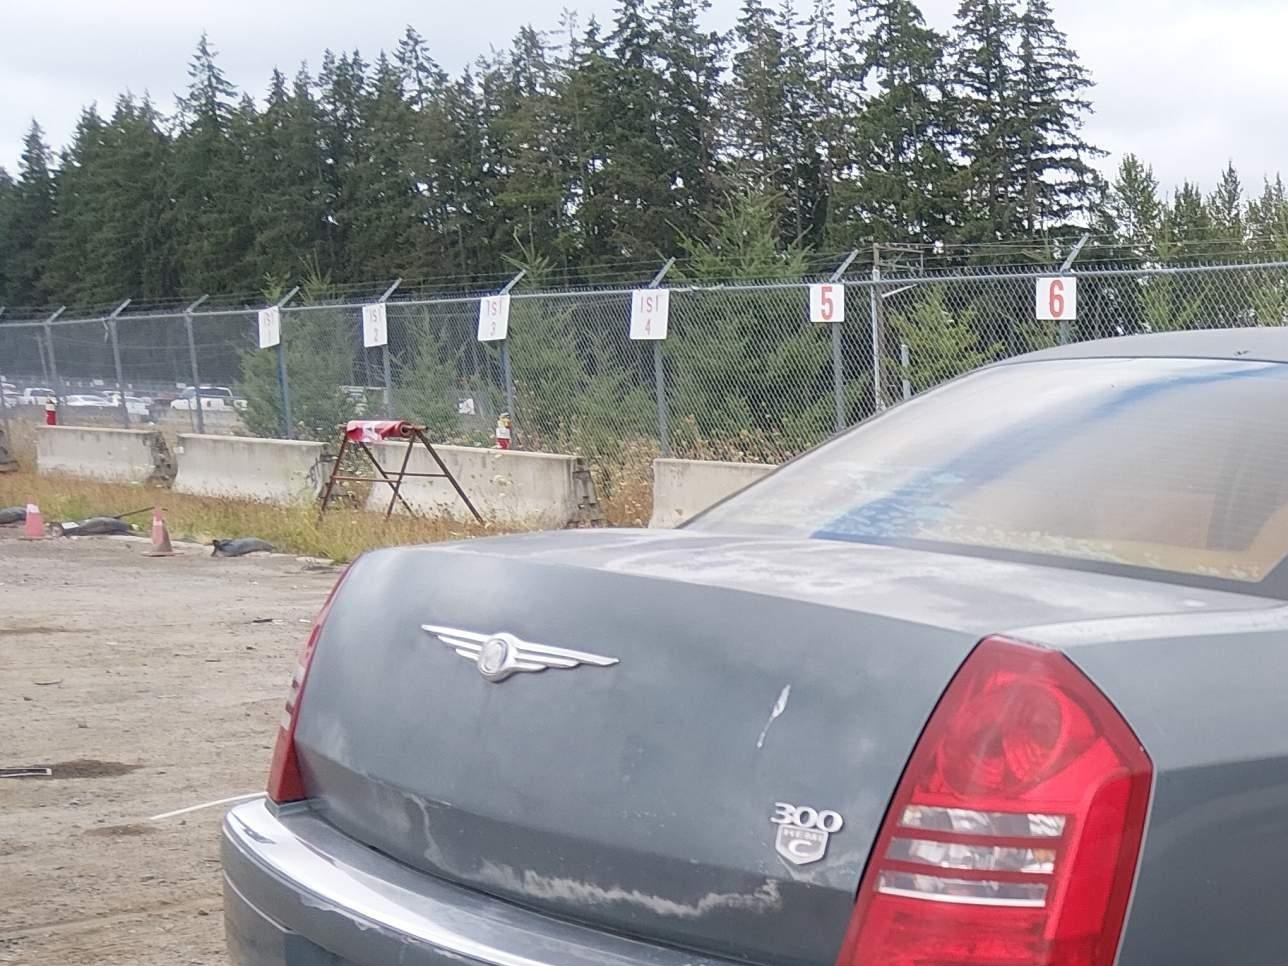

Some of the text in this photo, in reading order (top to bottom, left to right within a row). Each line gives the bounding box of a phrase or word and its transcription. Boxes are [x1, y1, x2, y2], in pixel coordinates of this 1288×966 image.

[820, 285, 833, 321] 5
[1049, 279, 1065, 320] 6
[644, 317, 652, 337] 4
[770, 801, 843, 833] 300
[788, 839, 813, 857] C
